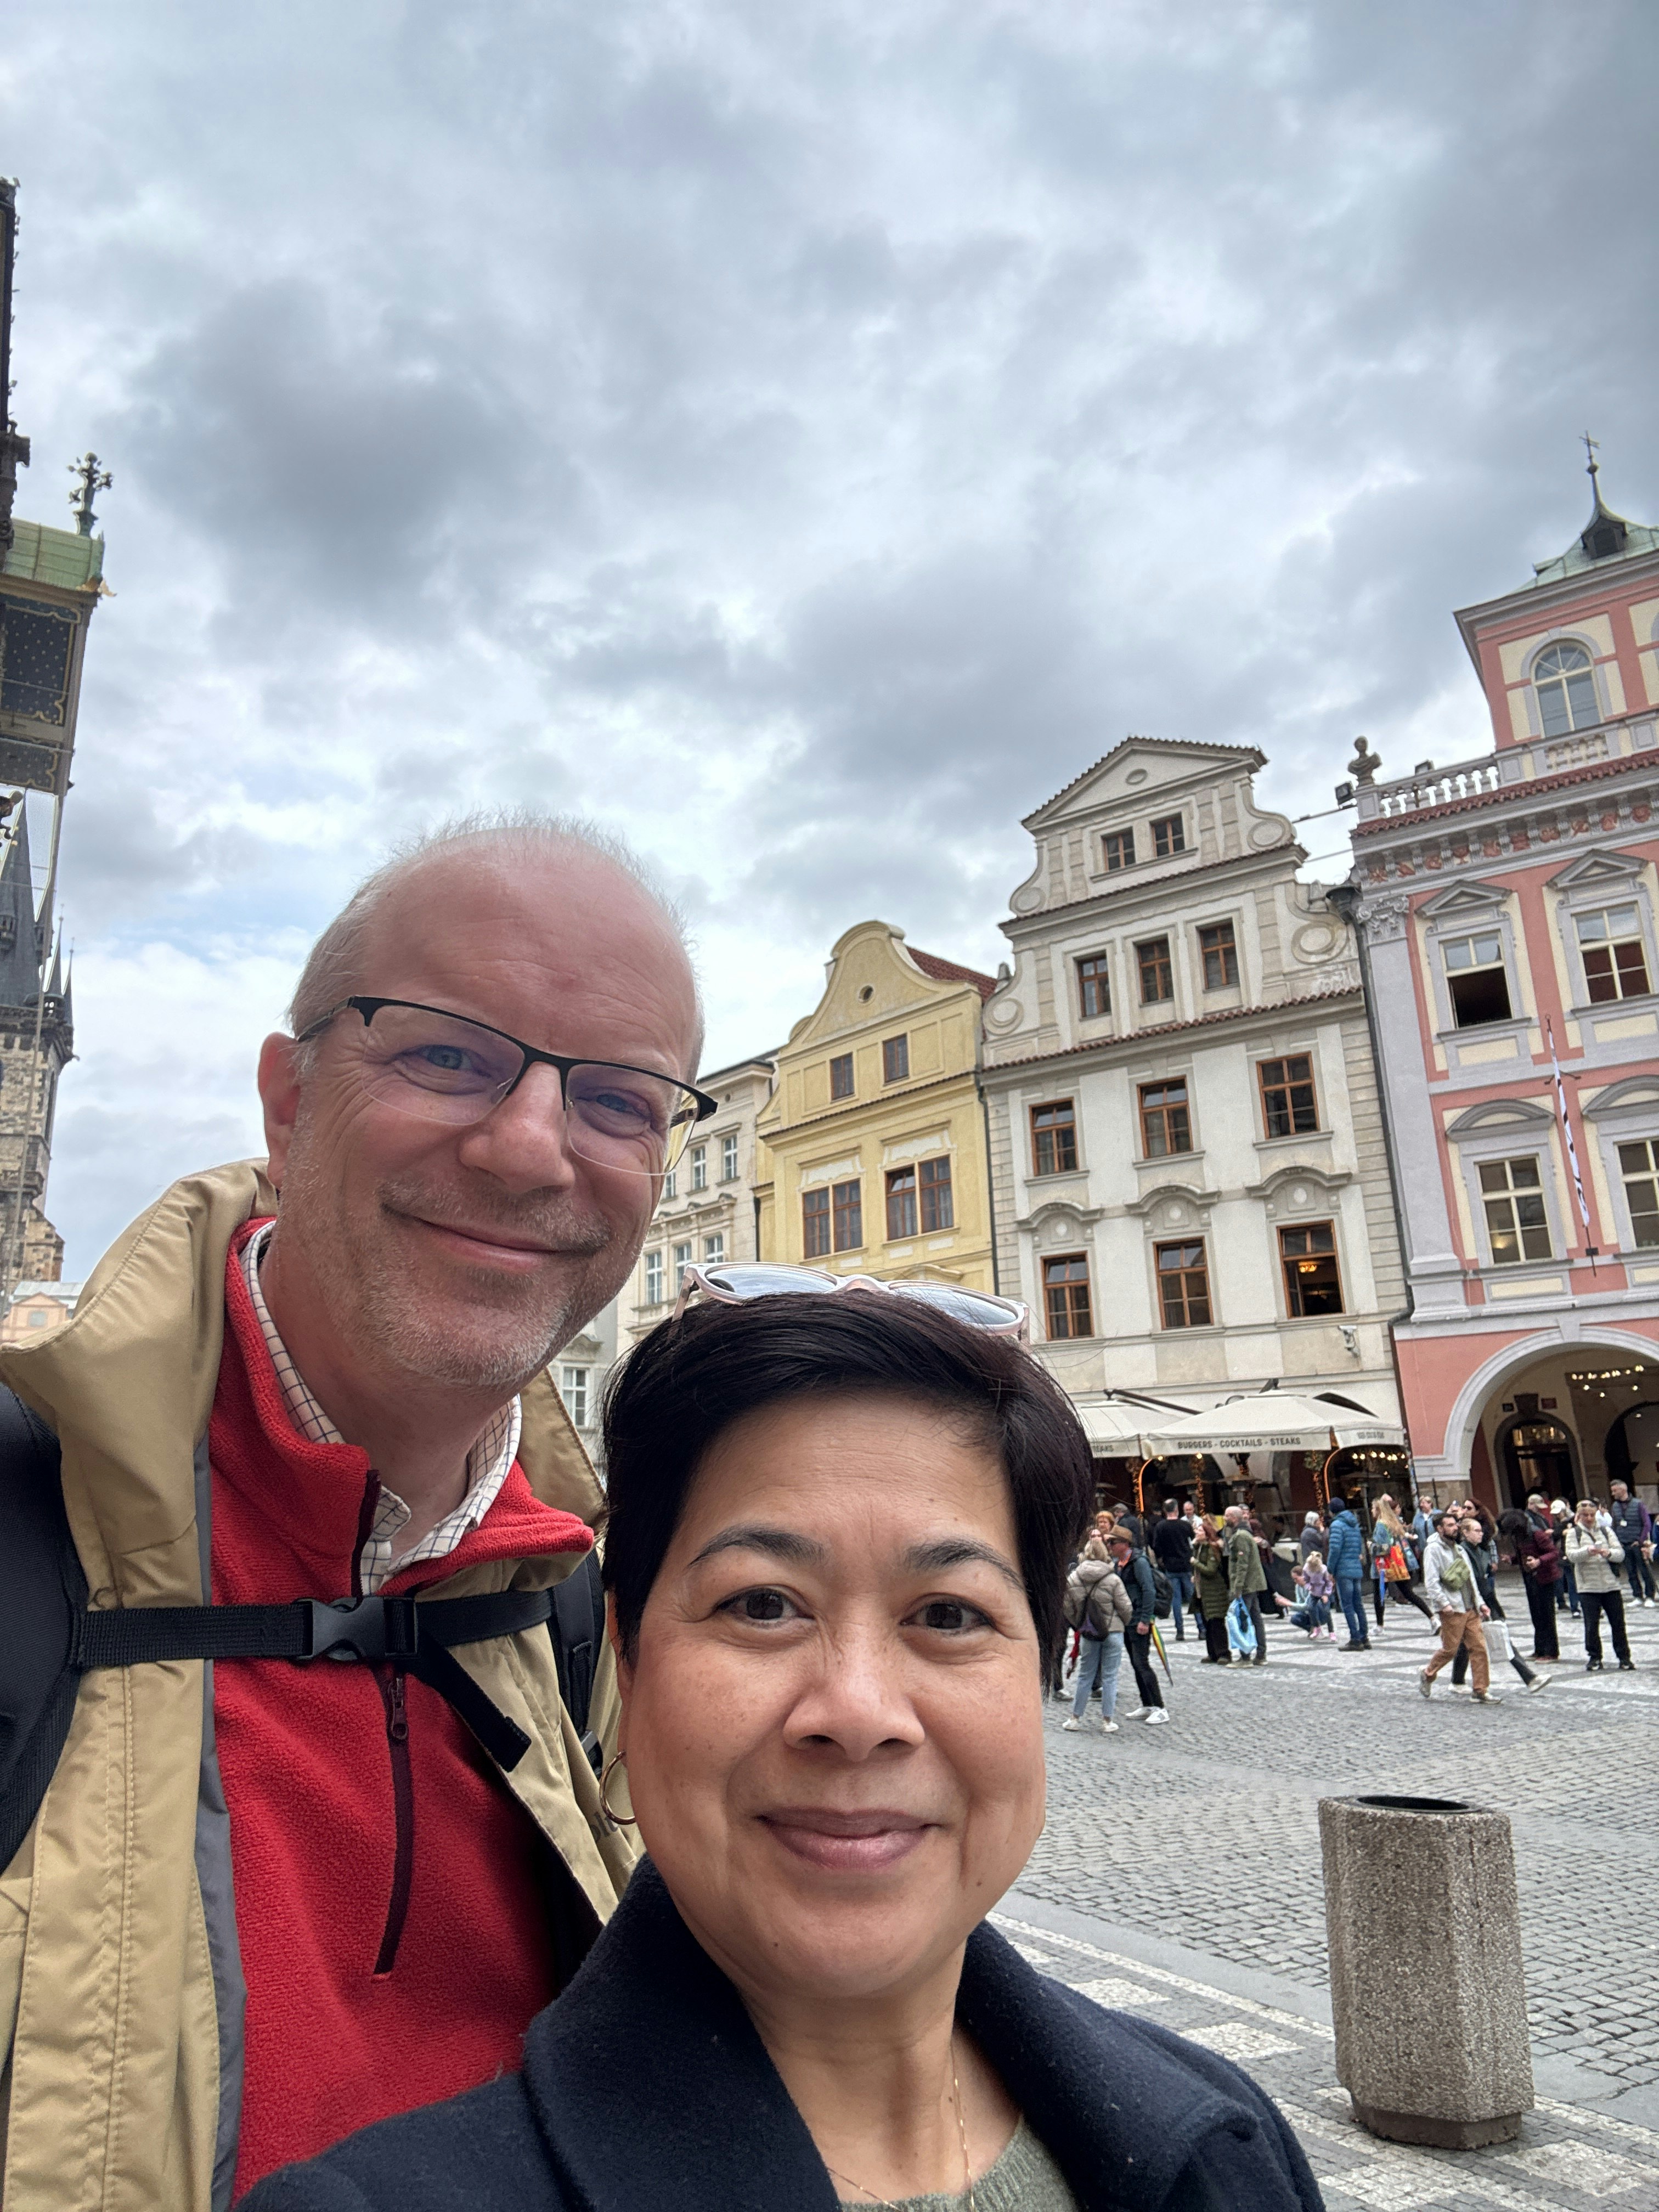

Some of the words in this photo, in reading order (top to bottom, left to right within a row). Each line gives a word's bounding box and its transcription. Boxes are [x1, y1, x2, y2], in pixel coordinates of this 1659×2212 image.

[1177, 1440, 1213, 1449] BURGERS
[1220, 1438, 1263, 1448] COCKTAILS
[1270, 1437, 1301, 1446] STEAKS
